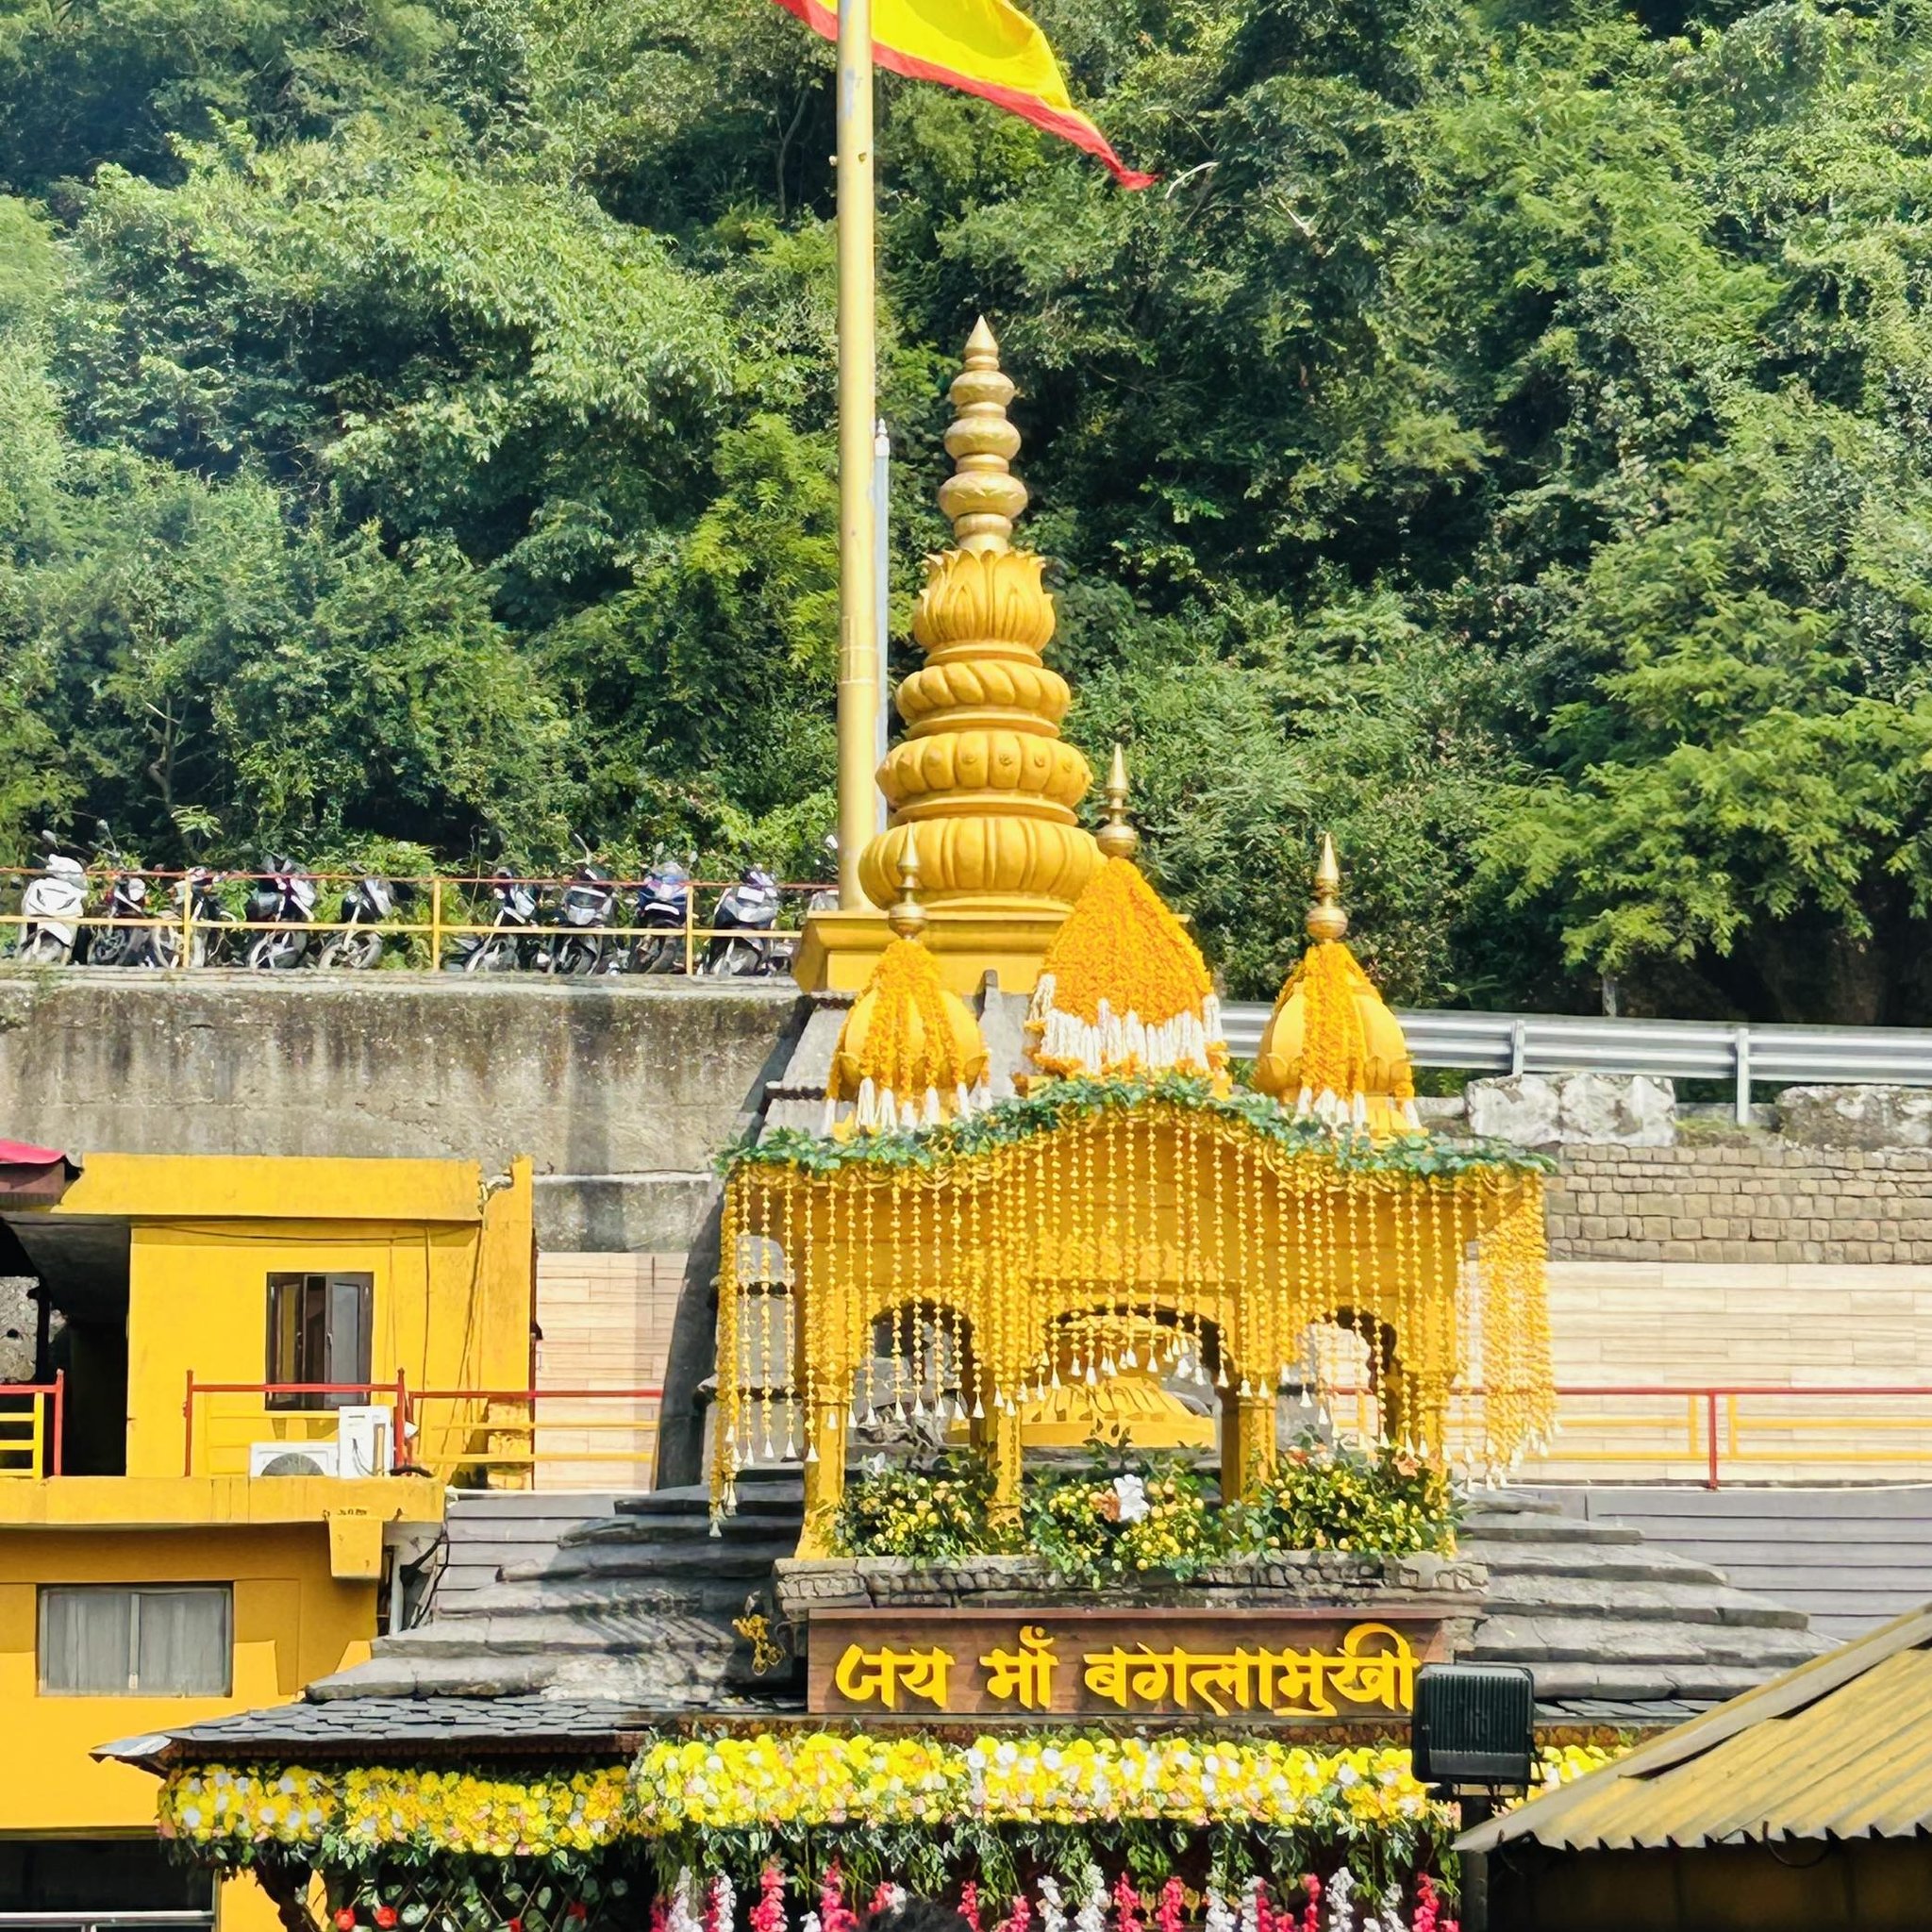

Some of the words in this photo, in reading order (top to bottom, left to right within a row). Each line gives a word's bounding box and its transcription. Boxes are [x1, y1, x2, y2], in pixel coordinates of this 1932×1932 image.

[835, 1643, 955, 1708] जय
[979, 1624, 1059, 1709] माँ
[1083, 1622, 1422, 1717] बगलामुखी
